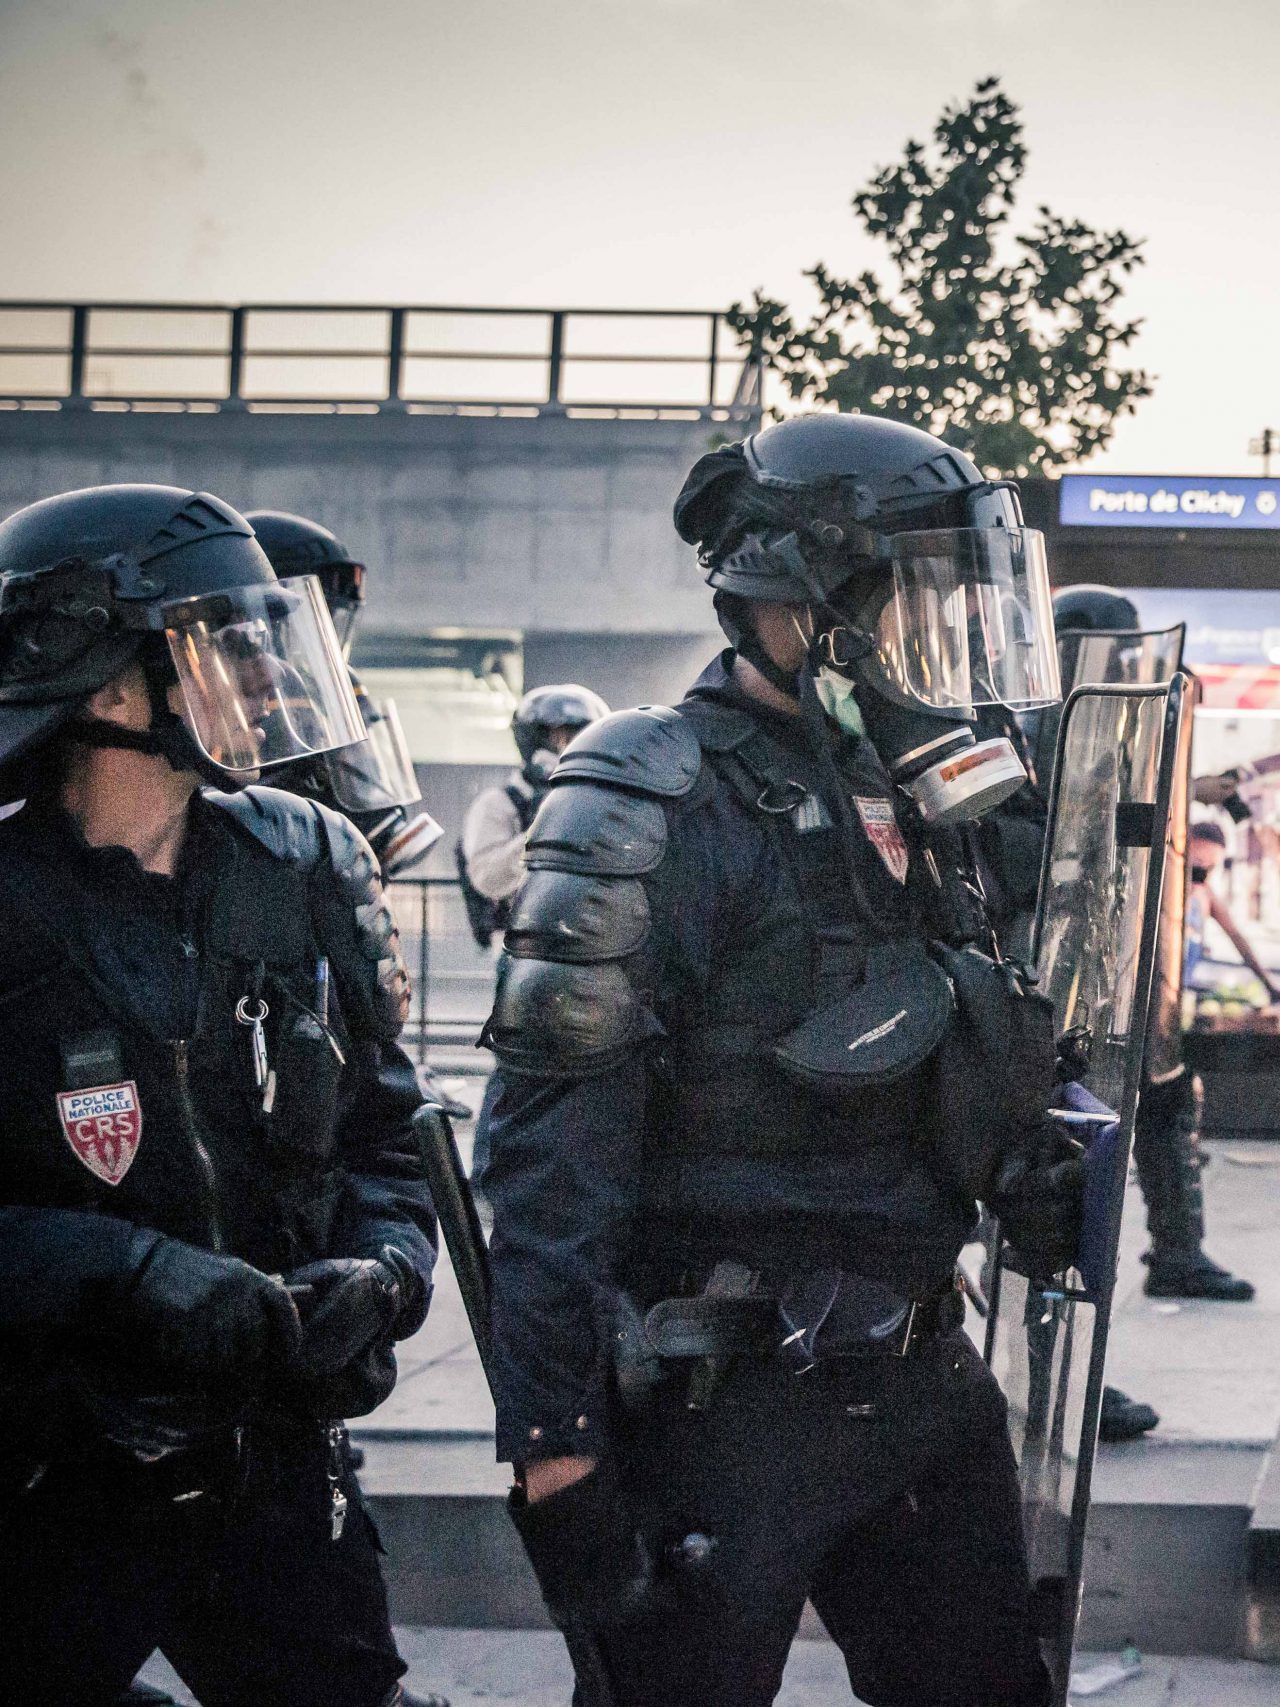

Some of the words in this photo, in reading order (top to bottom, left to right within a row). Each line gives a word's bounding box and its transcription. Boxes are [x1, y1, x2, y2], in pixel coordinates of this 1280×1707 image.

[1089, 488, 1148, 512] Porte
[1149, 488, 1179, 513] de
[1180, 489, 1246, 518] Clichy
[69, 1100, 132, 1119] NATIONALE
[71, 1091, 125, 1109] POLICE
[76, 1114, 133, 1142] CRS
